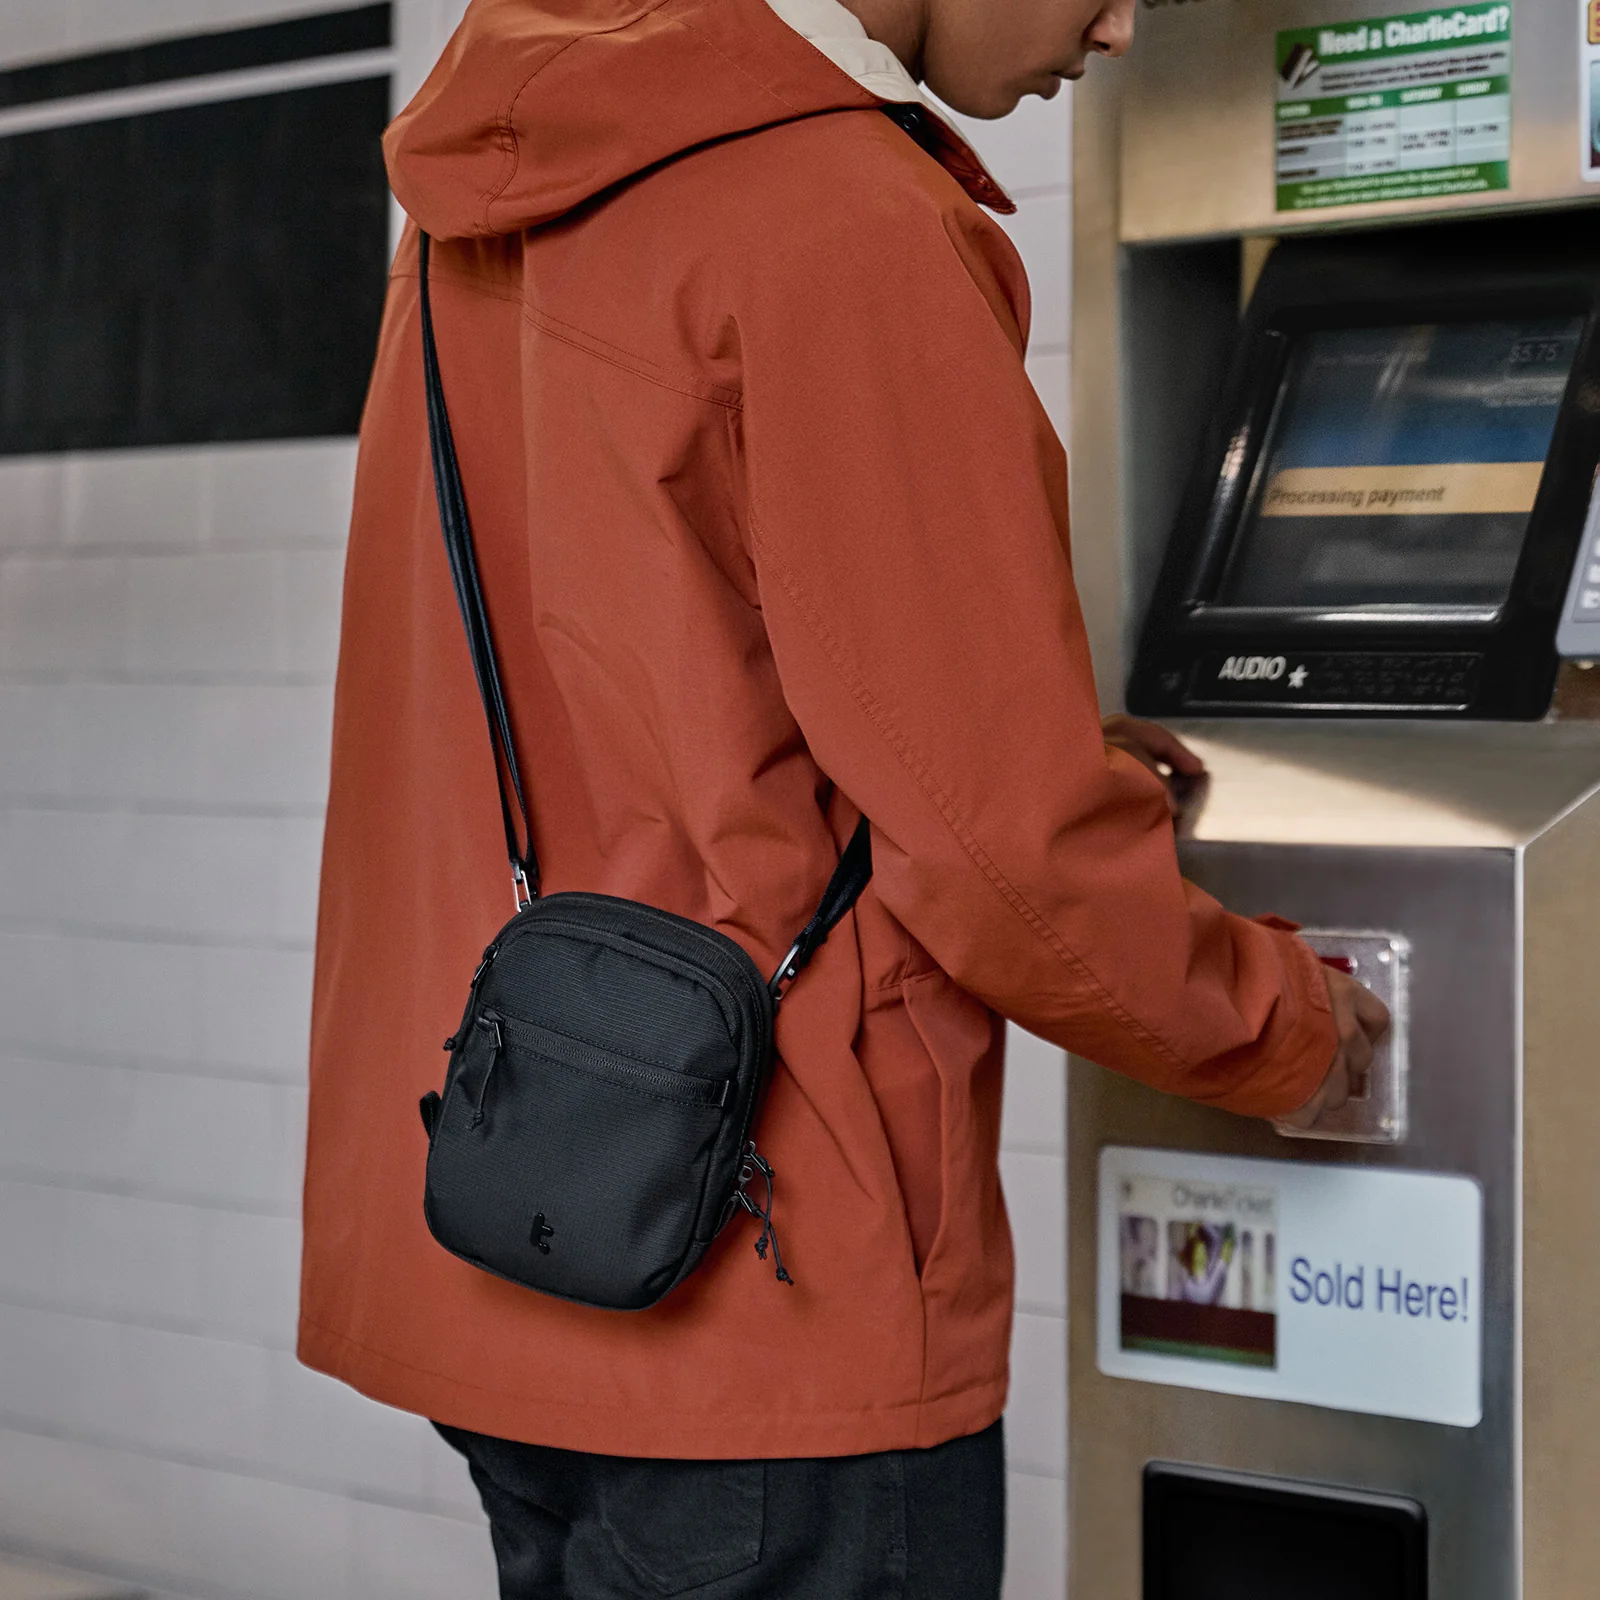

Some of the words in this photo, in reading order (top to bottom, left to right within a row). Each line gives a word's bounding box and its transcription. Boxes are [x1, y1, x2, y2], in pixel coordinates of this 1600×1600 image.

[1318, 26, 1367, 54] Need
[1370, 29, 1382, 49] a
[1384, 6, 1510, 47] CharlieCard?
[1268, 488, 1365, 508] Processing
[1366, 486, 1446, 508] payment
[1218, 656, 1287, 681] AUDIO
[1289, 1256, 1363, 1309] Sold
[1377, 1267, 1468, 1322] Here!
